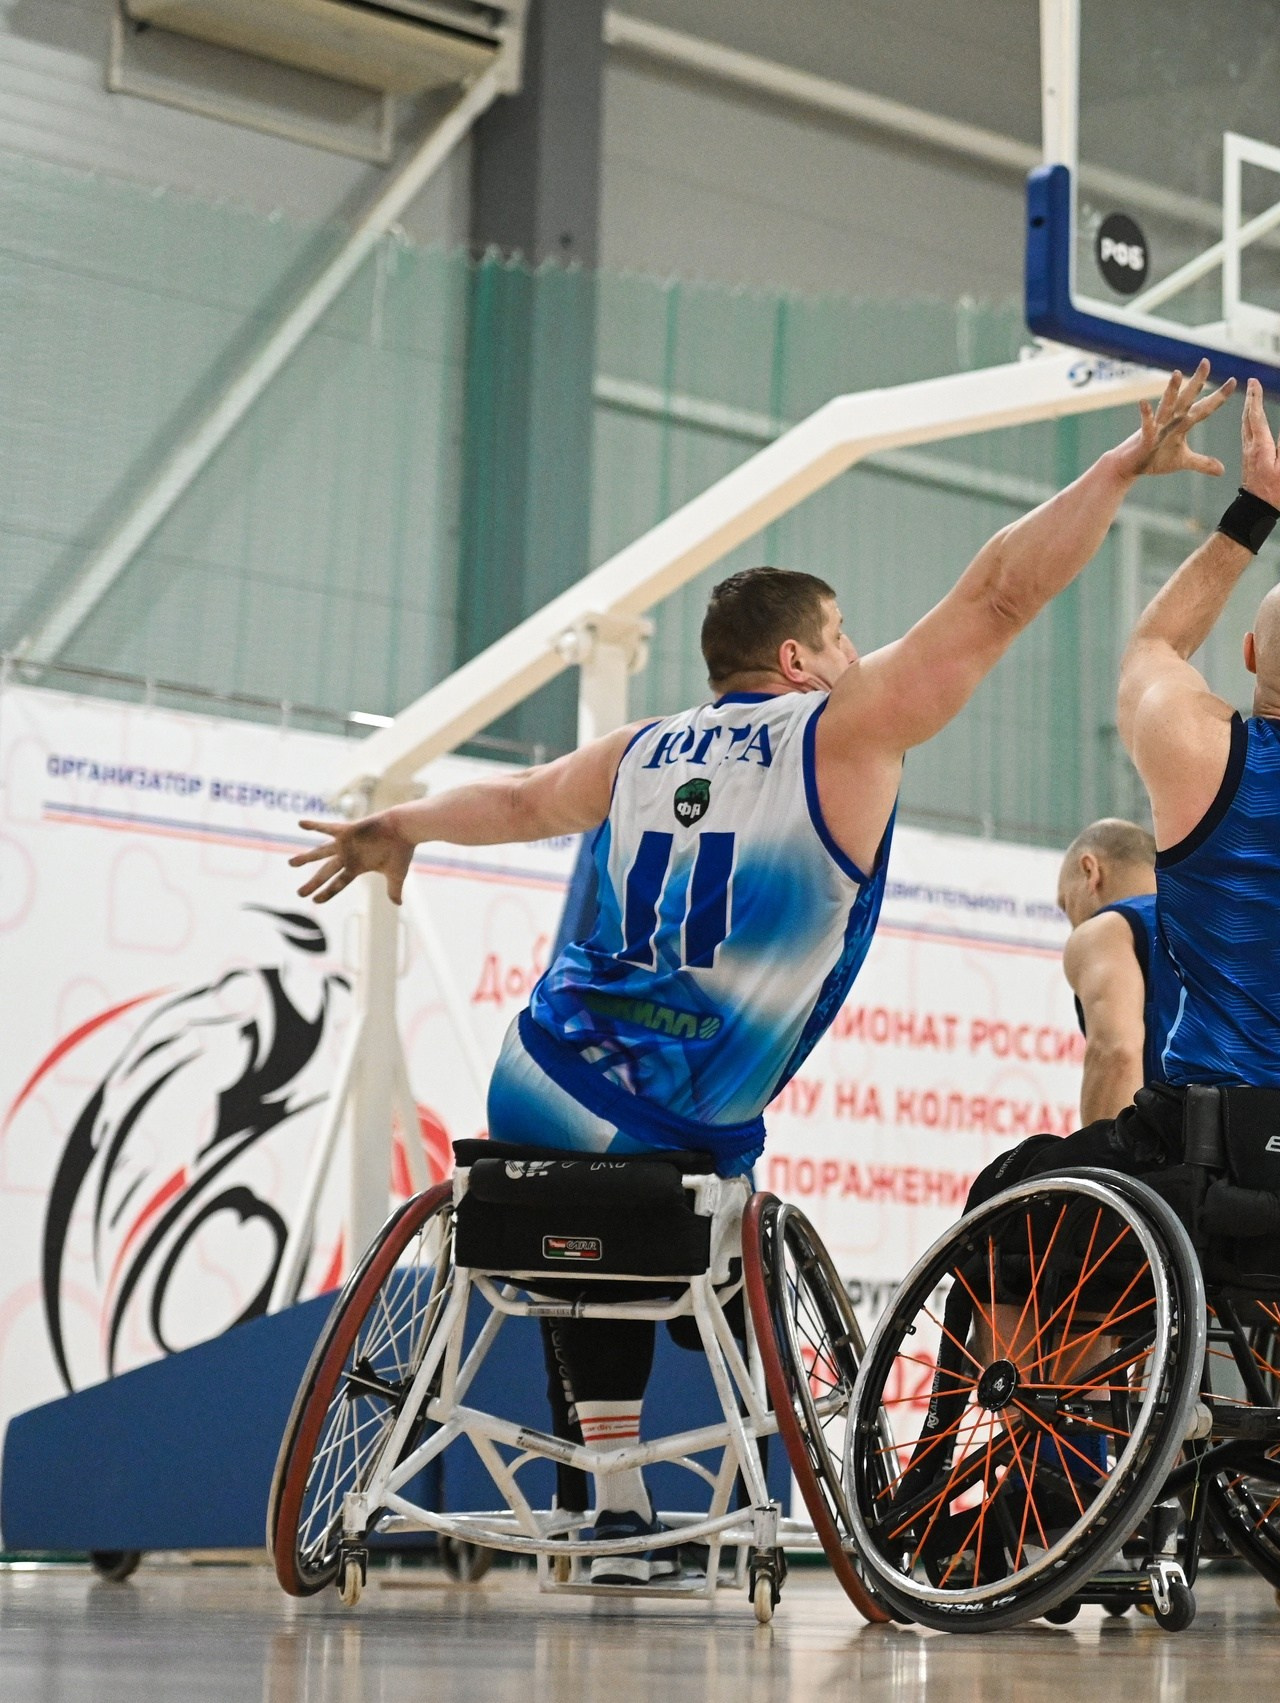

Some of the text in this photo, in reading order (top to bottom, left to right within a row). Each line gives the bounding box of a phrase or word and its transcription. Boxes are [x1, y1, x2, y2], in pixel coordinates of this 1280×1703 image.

[47, 753, 202, 796] ОРГАНИЗАТОР
[613, 831, 736, 971] 11
[836, 1082, 881, 1121] НА
[896, 1089, 1078, 1137] КОЛЯСКАХ
